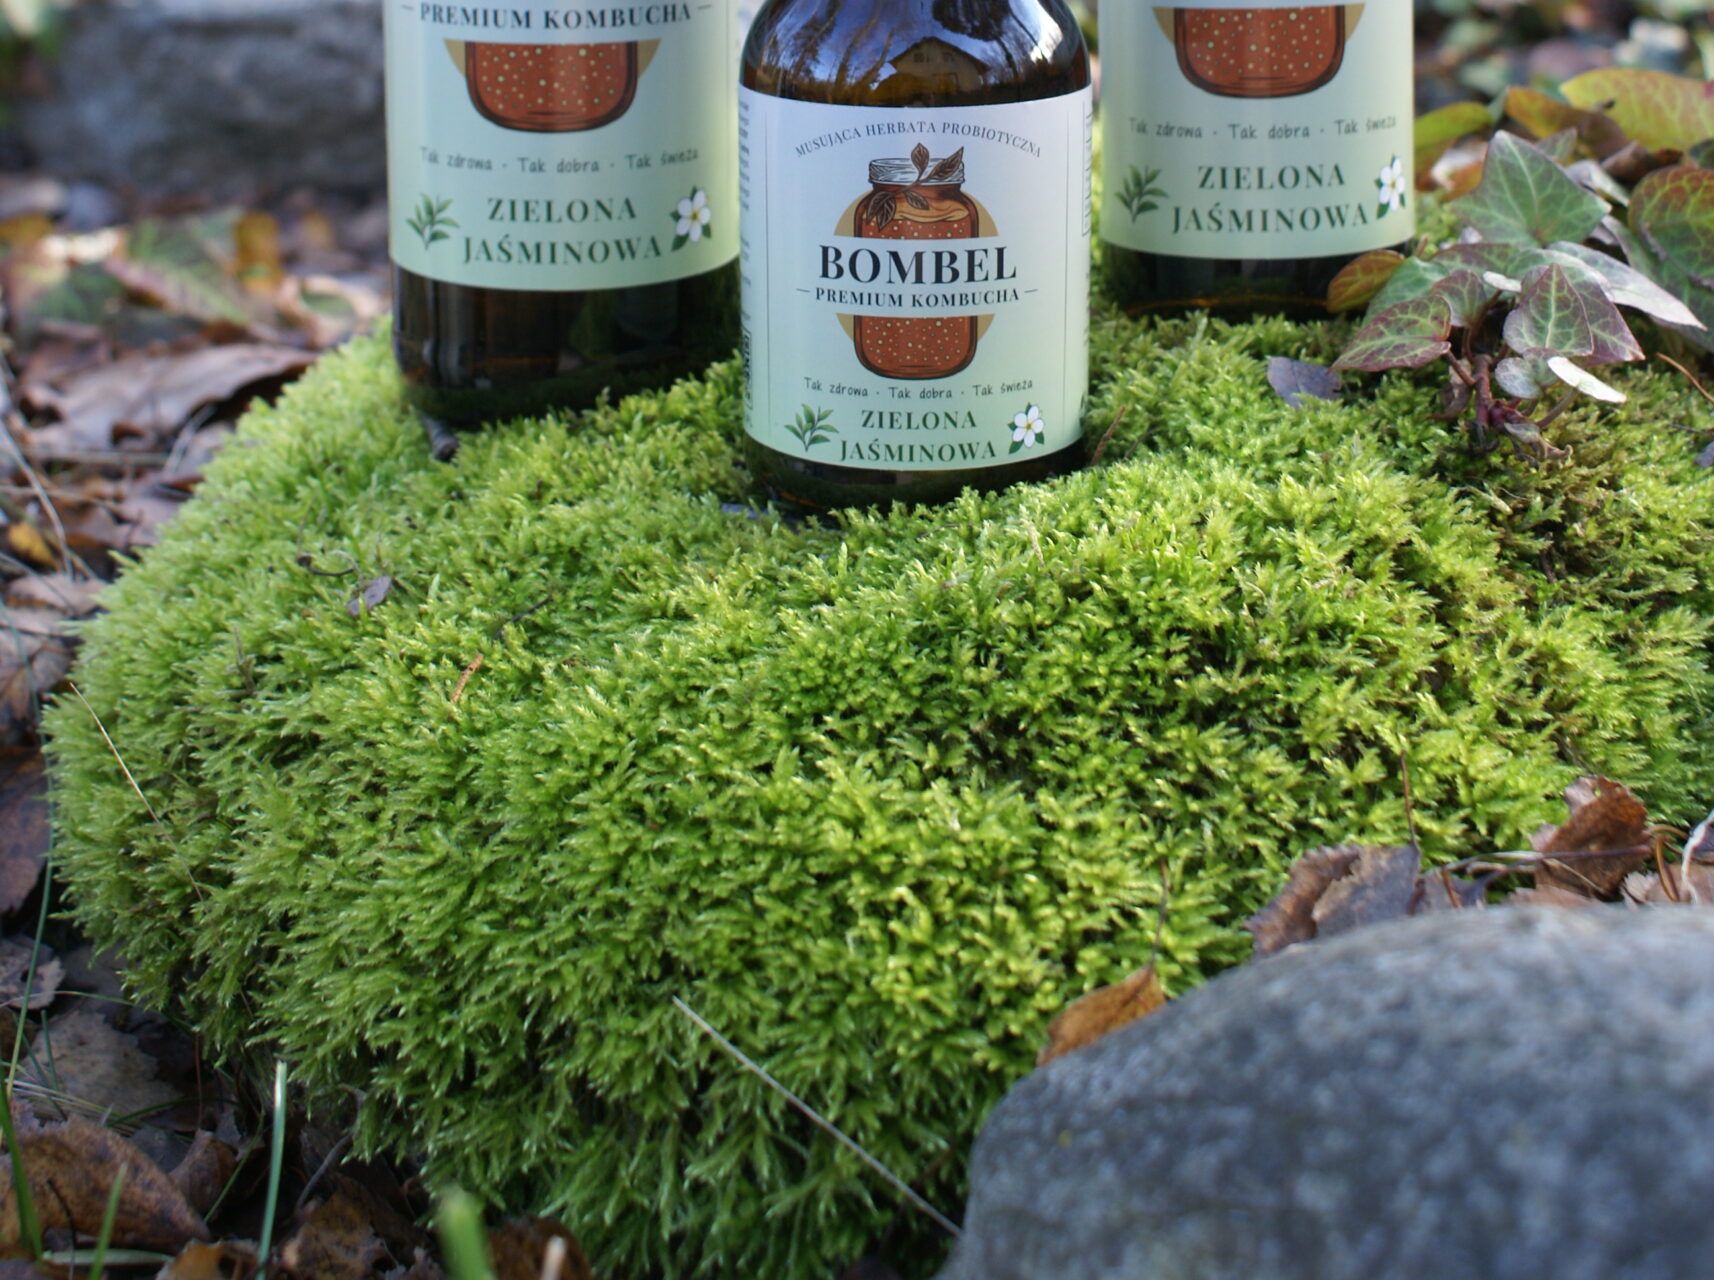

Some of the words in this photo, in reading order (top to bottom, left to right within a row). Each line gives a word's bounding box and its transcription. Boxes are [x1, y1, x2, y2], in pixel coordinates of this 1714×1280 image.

[420, 2, 532, 30] PREMIUM
[543, 3, 692, 30] KOMBUCHA
[795, 128, 862, 158] MUSUJĄCA
[866, 121, 937, 136] HERBATA
[942, 122, 1042, 158] PROBIOTYCZNA
[1128, 117, 1148, 135] Tak
[1156, 120, 1202, 139] zdrowa
[1228, 123, 1257, 140] Tak
[1268, 122, 1310, 140] dobra
[1333, 119, 1358, 136] Tak
[419, 145, 440, 165] Tak
[446, 153, 493, 171] zdrowa
[517, 157, 546, 173] Tak
[556, 157, 600, 173] dobra
[624, 153, 651, 169] Tak
[1198, 163, 1346, 190] ZIELONA
[488, 197, 637, 223] ZIELONA
[1171, 202, 1369, 234] JAŚMINOWA
[462, 234, 662, 265] JAŚMINOWA
[819, 245, 1017, 285] BOMBEL
[816, 287, 903, 308] PREMIUM
[911, 288, 1020, 308] KOMBUCHA
[804, 377, 823, 392] Tak
[829, 381, 869, 397] zdrowa
[888, 387, 911, 399] Tak
[919, 386, 952, 400] dobra
[972, 384, 993, 396] Tak
[861, 409, 977, 431] ZIELONA
[840, 438, 997, 462] JAŚMINOWA
